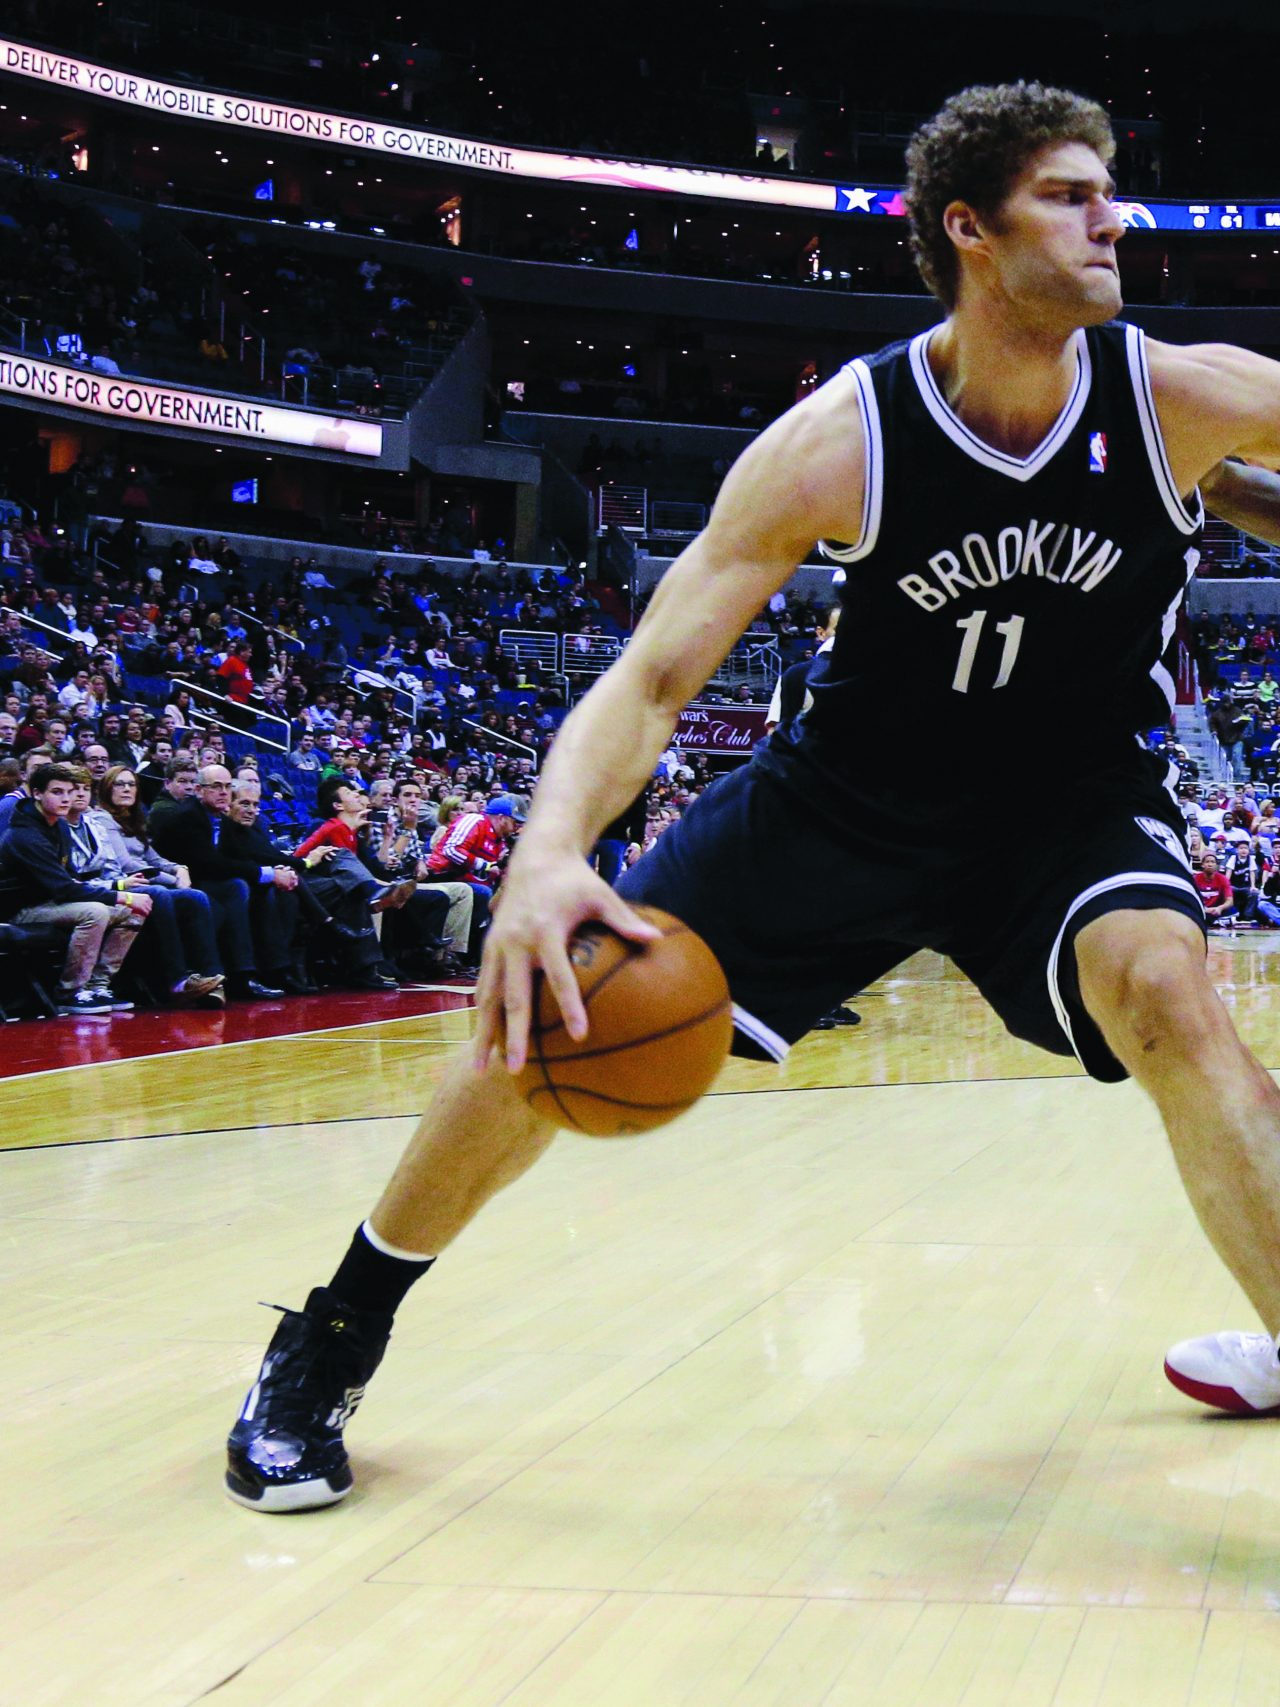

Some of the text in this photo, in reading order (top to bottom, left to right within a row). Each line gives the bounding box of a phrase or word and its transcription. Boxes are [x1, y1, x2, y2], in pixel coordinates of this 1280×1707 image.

[7, 47, 515, 171] DELIVER YOUR MOBILE SOLUTIONS FOR GOVERNMENT.
[1193, 215, 1205, 229] 0
[1220, 215, 1242, 228] 61
[0, 359, 266, 434] TIONS FOR GOVERNMENT.
[897, 518, 1123, 613] BROOKLYN
[952, 609, 1025, 694] 11
[709, 720, 752, 746] Club
